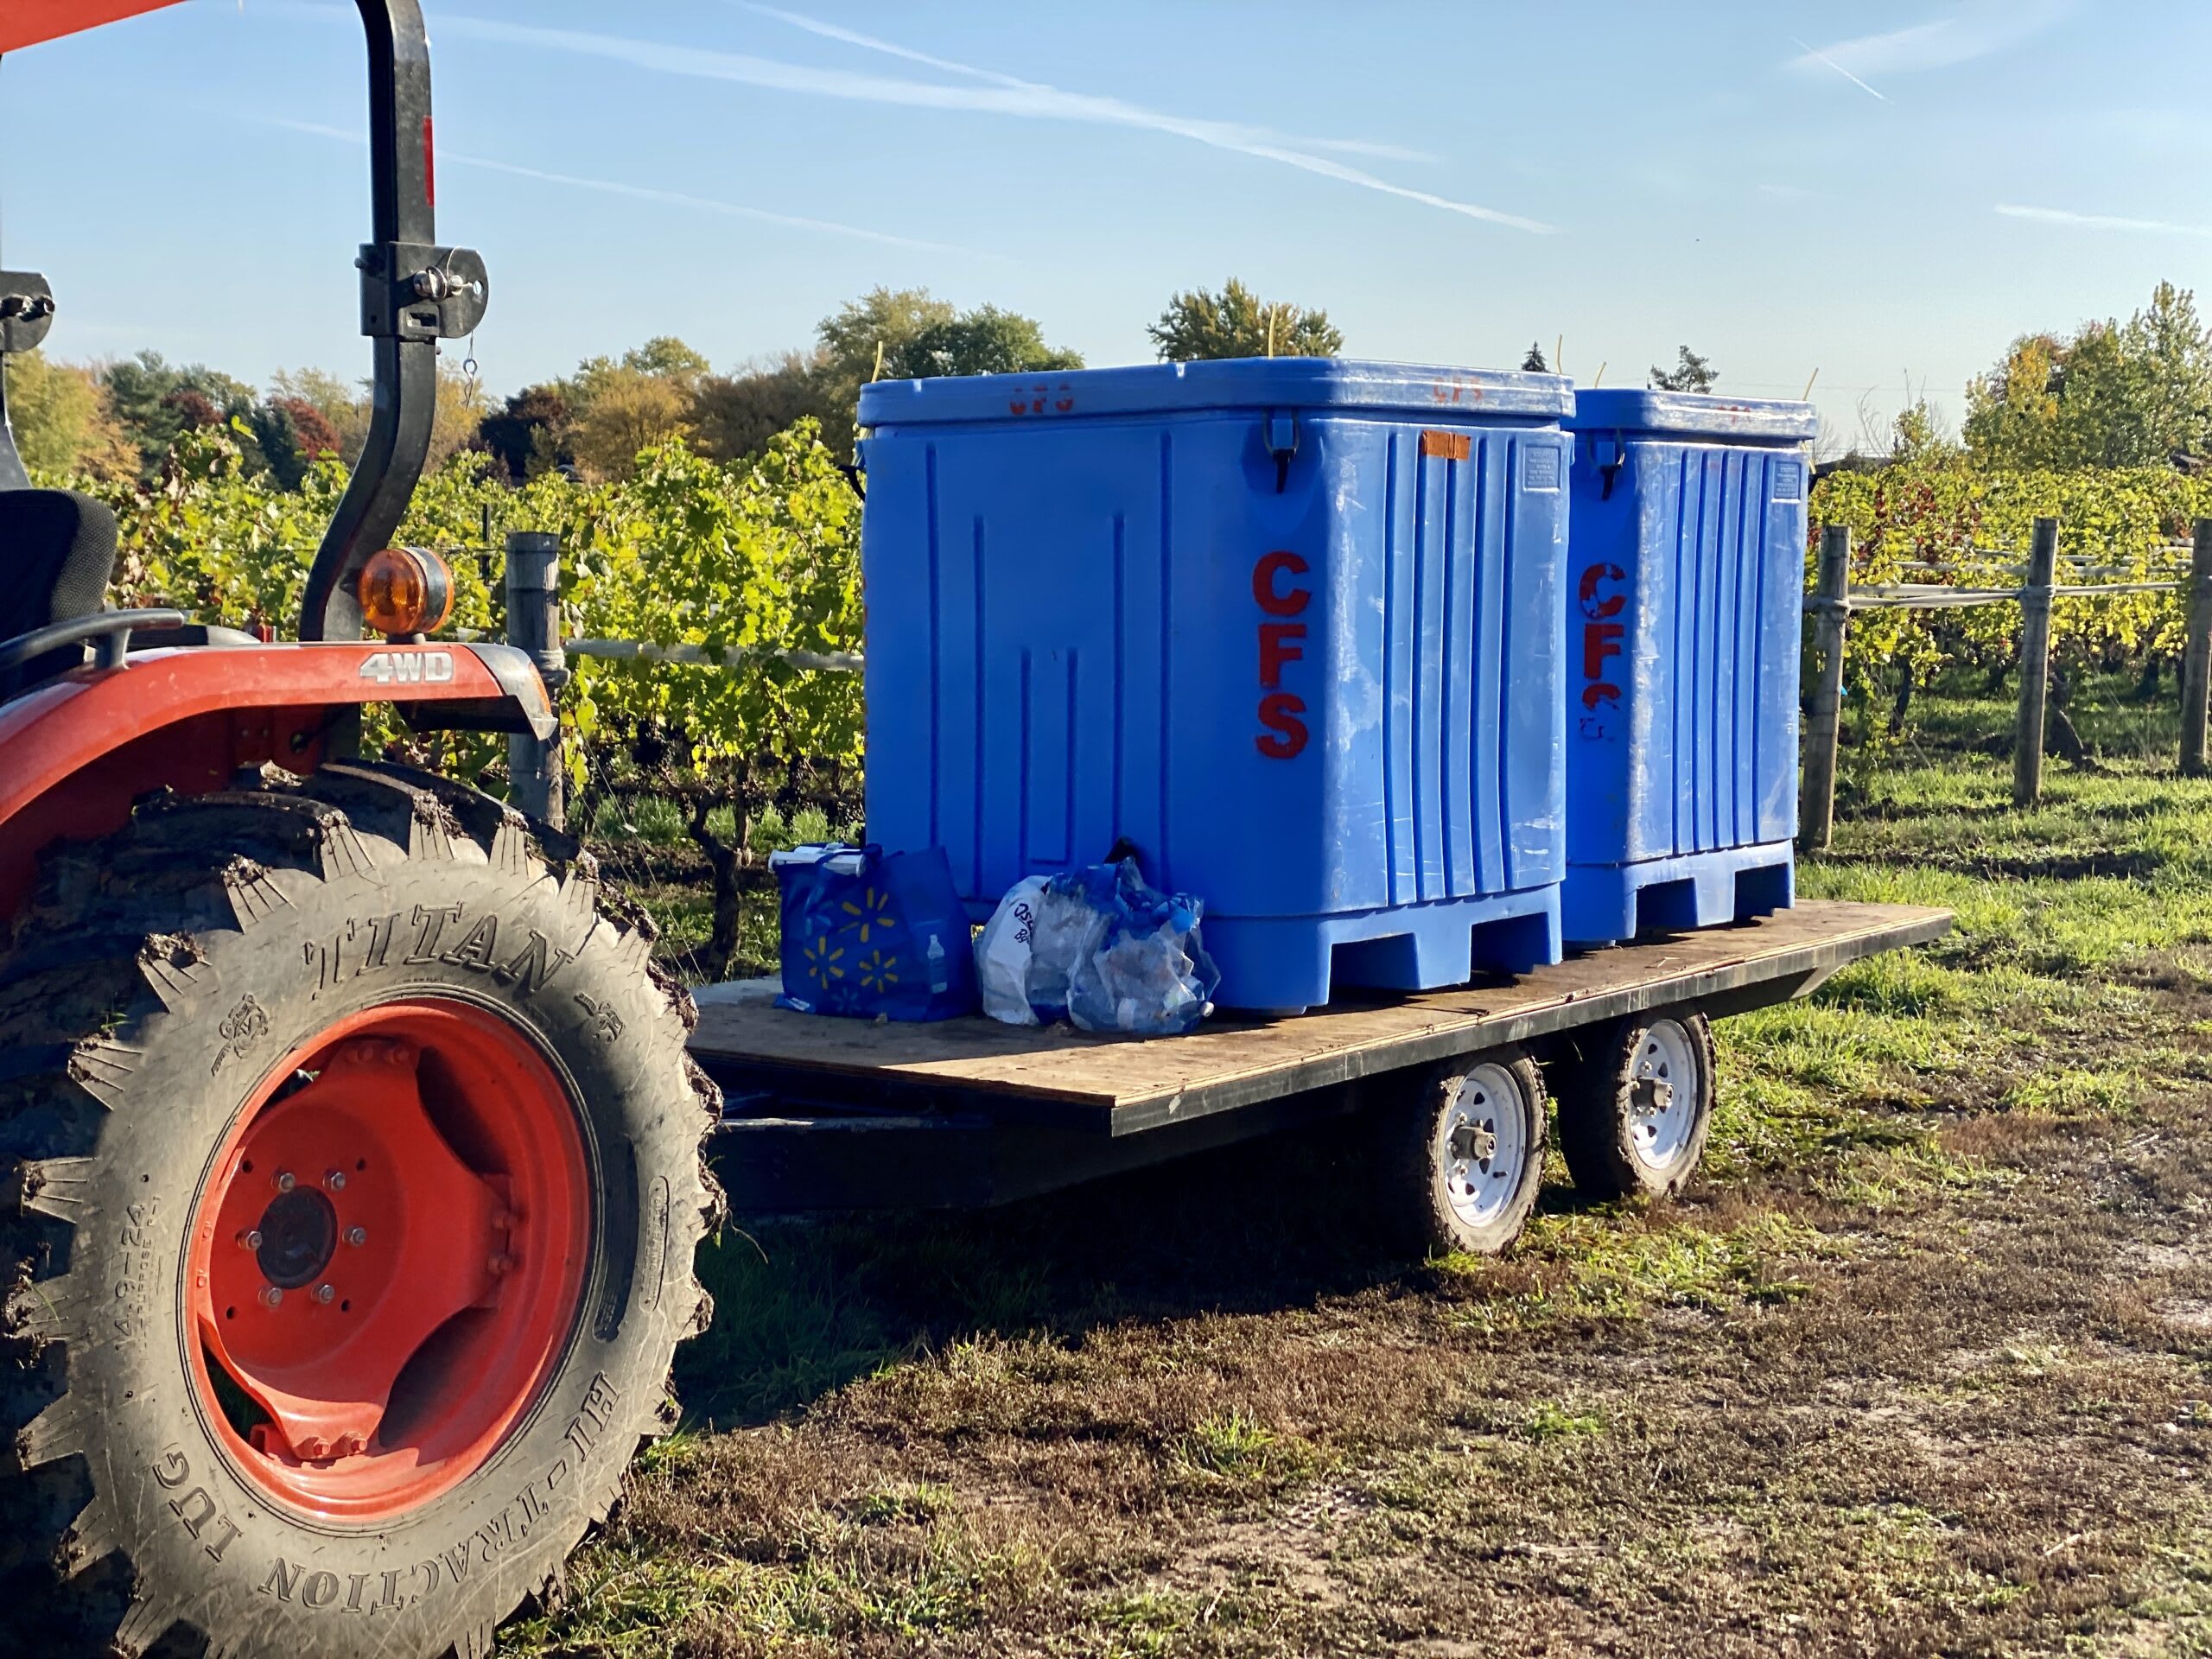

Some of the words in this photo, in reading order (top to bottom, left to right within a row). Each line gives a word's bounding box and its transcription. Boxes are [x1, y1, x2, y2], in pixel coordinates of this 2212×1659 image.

[359, 652, 453, 683] 4WD
[1252, 550, 1311, 760] CFS
[302, 900, 575, 1001] TITAN
[152, 1450, 245, 1563] LUG
